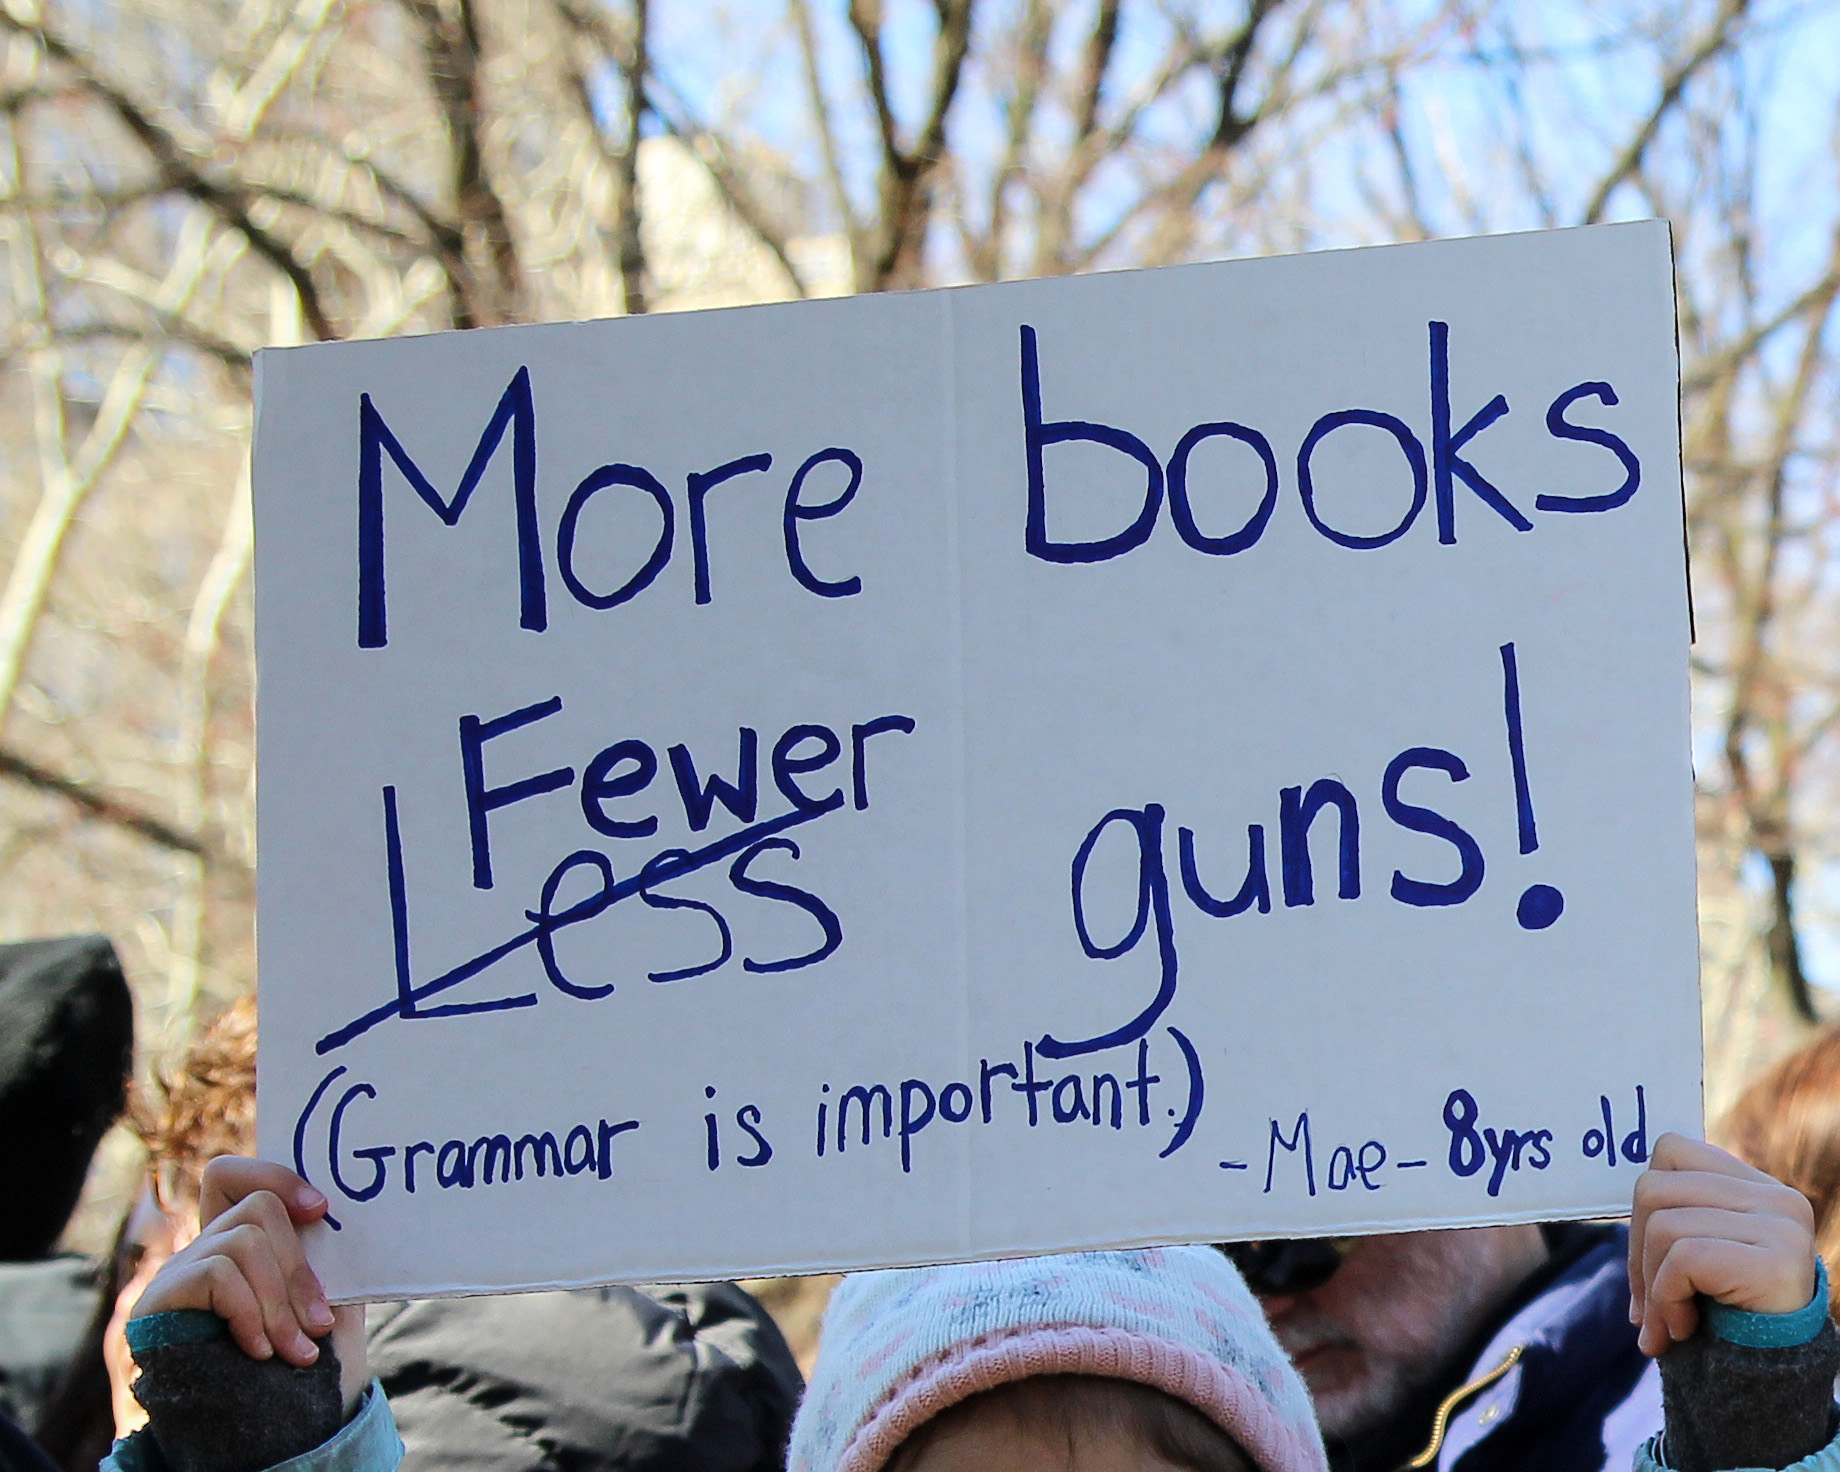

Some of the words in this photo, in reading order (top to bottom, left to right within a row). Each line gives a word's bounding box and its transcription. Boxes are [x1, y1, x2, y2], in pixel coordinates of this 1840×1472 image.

[358, 365, 863, 648] More
[1020, 320, 1641, 564] books
[382, 785, 843, 1019] Less
[1034, 641, 1565, 1060] guns!
[459, 695, 916, 890] Fewer
[293, 1065, 639, 1232] (Grammar
[705, 1087, 772, 1170] is
[816, 1026, 1204, 1173] important.)
[1582, 1084, 1648, 1167] old
